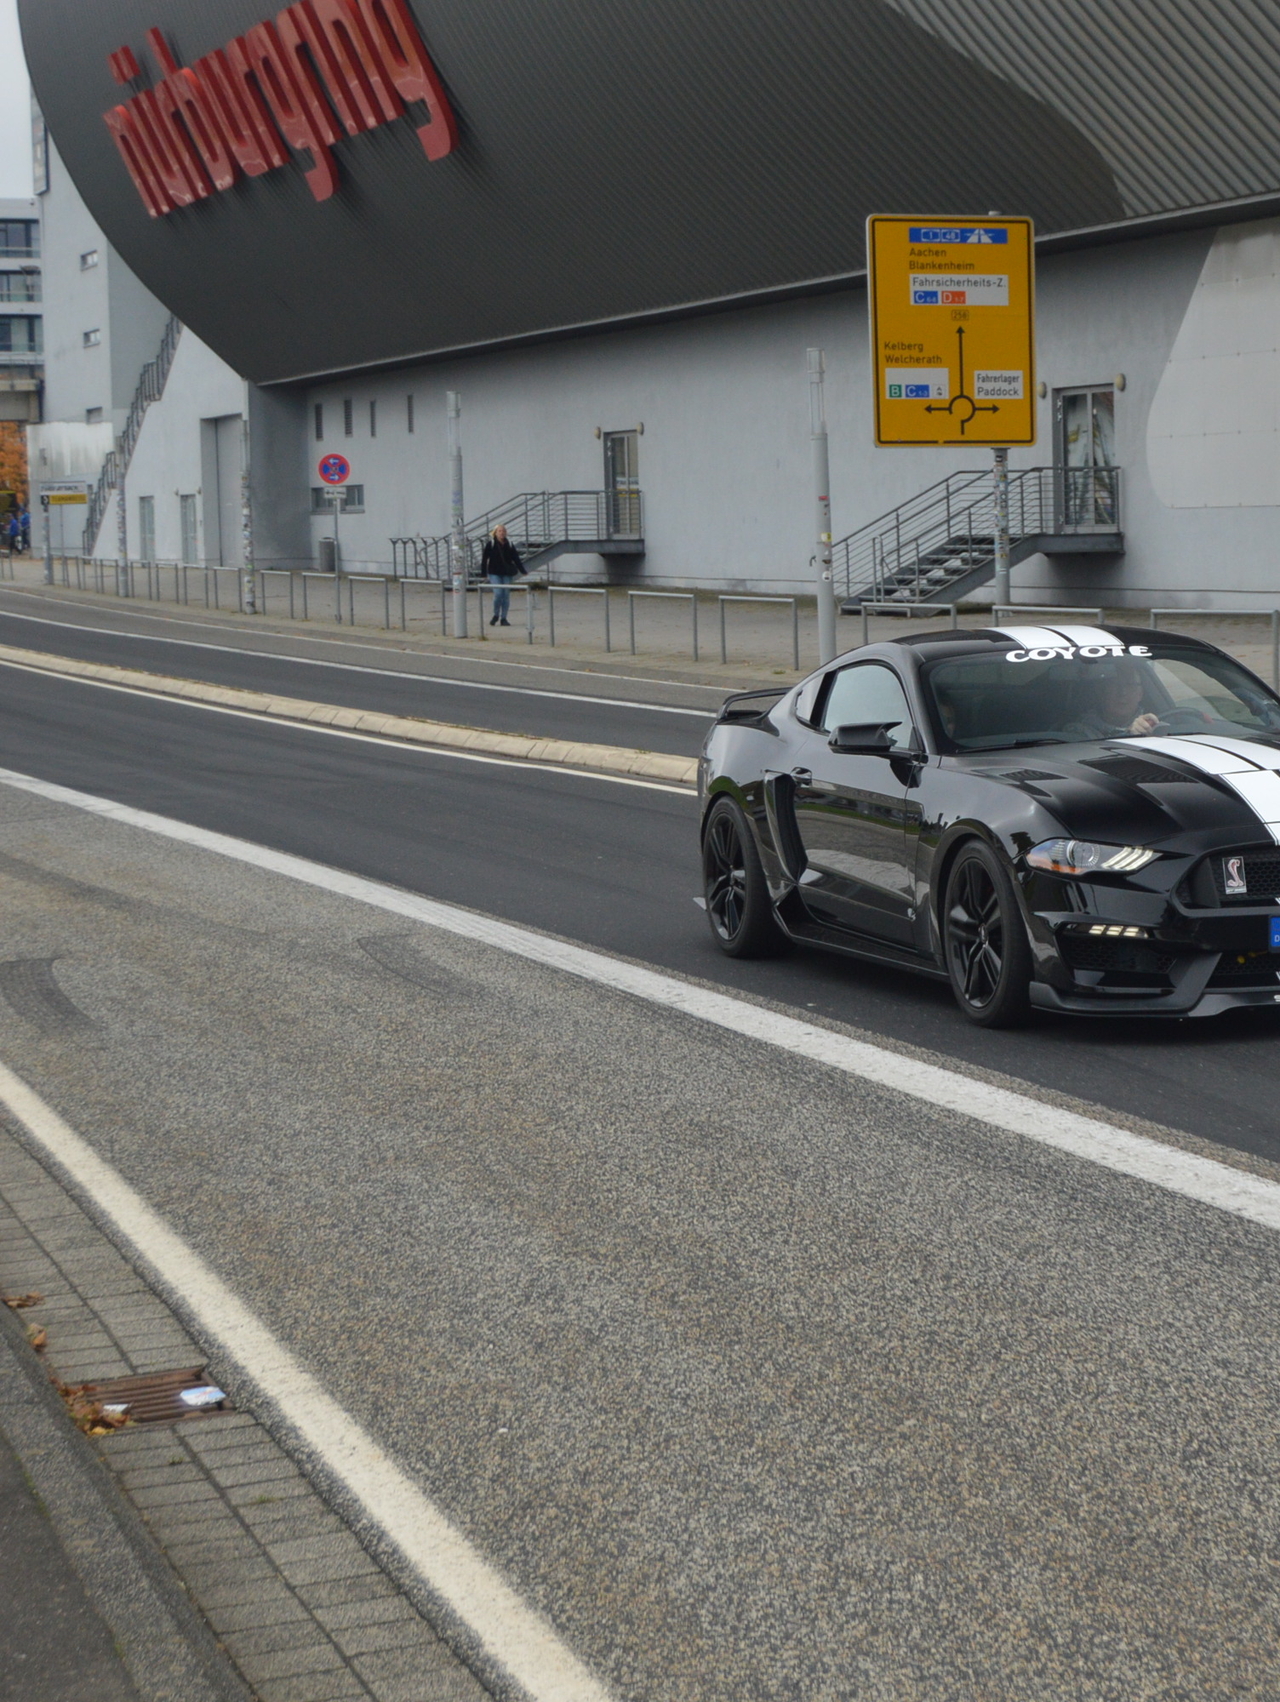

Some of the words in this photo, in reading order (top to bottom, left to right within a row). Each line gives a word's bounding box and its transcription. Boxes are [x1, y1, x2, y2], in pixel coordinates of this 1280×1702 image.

[909, 248, 947, 257] Aachen
[909, 261, 975, 270] Blankenheim
[912, 277, 1007, 288] Fahrsicherheits-Z.
[915, 292, 925, 303] C
[943, 293, 952, 303] D
[884, 342, 924, 352] Kelberg
[885, 355, 942, 364] Welcherath
[977, 374, 1020, 385] Fahrerlager
[891, 386, 900, 397] B
[907, 386, 916, 397] C
[977, 387, 1019, 396] Paddock
[1005, 645, 1153, 663] COYOTE
